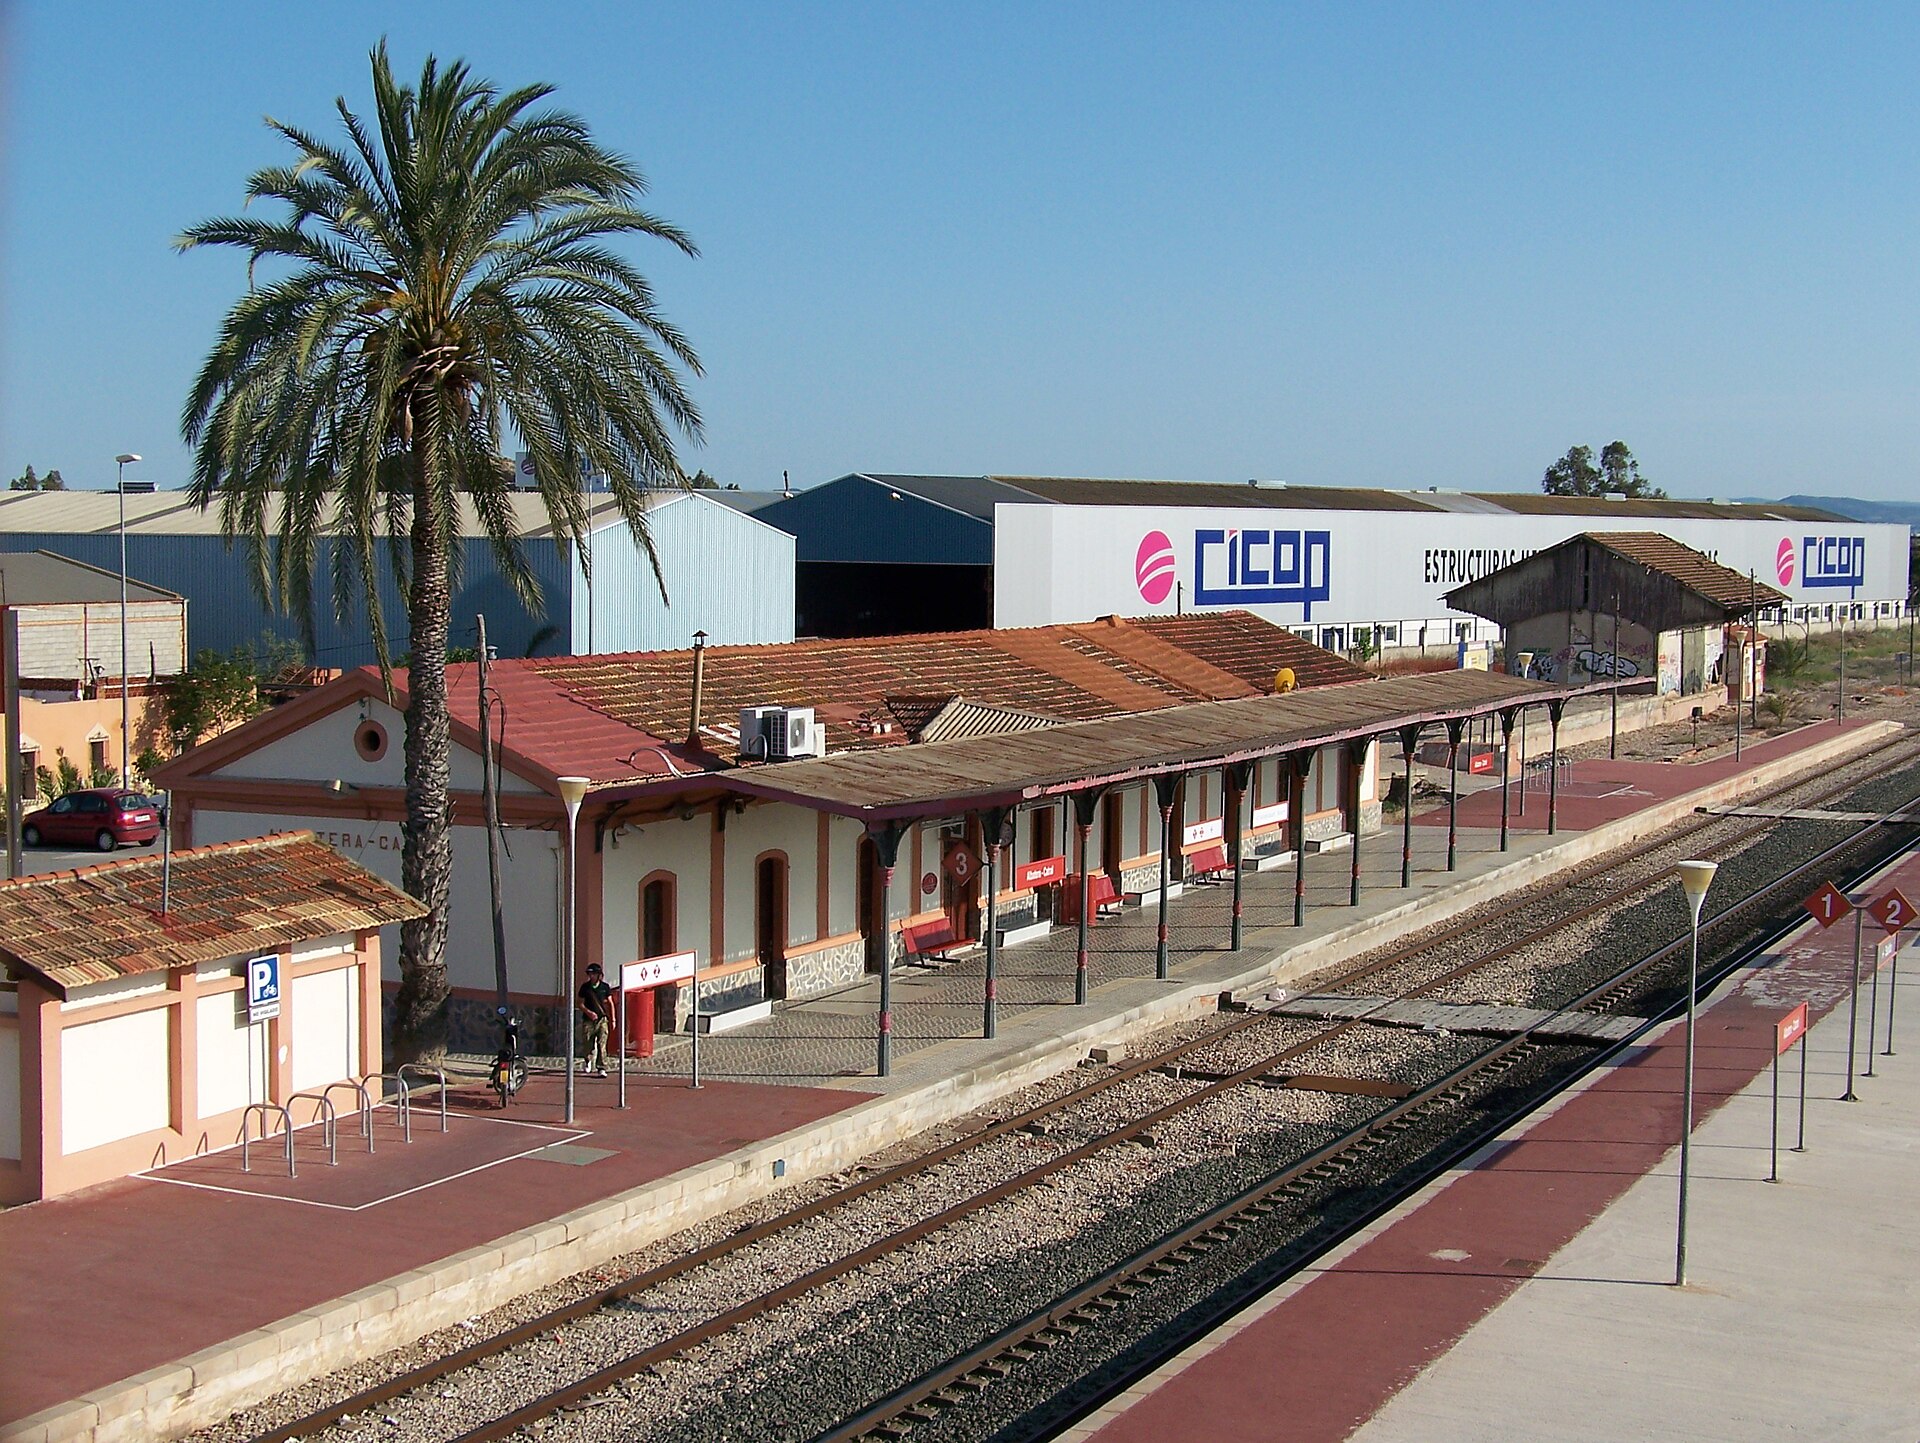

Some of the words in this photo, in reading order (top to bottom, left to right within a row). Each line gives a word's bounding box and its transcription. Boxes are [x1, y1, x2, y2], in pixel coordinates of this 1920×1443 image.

[955, 852, 968, 875] 3
[1821, 893, 1832, 918] 1
[1885, 899, 1901, 925] 2
[252, 962, 272, 1001] P
